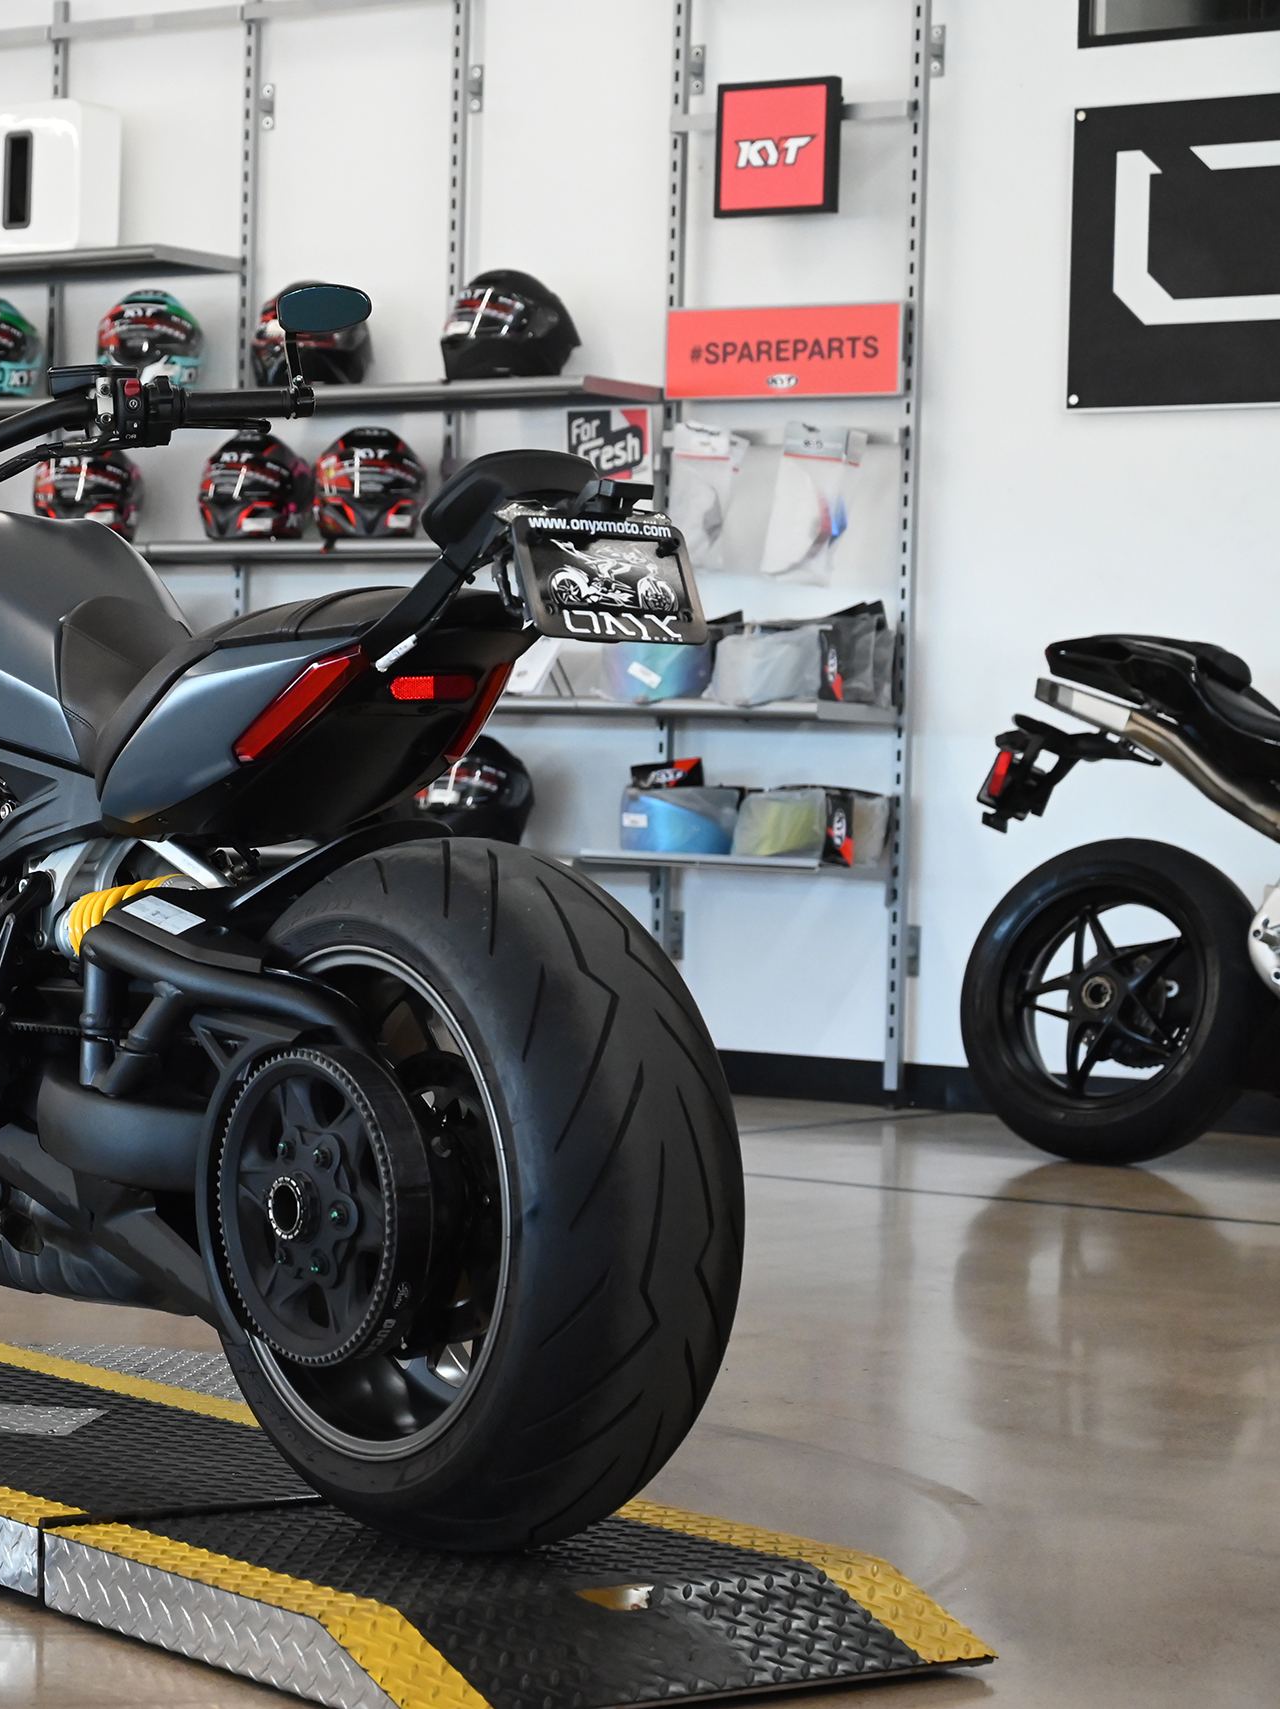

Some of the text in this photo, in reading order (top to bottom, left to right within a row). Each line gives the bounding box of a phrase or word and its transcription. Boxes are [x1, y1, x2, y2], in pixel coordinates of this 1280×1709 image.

[735, 134, 817, 169] KYT
[690, 335, 880, 365] #SPAREPARTS
[571, 417, 601, 447] For
[528, 517, 671, 538] www.onyxmoto.com
[563, 609, 682, 640] ONYX
